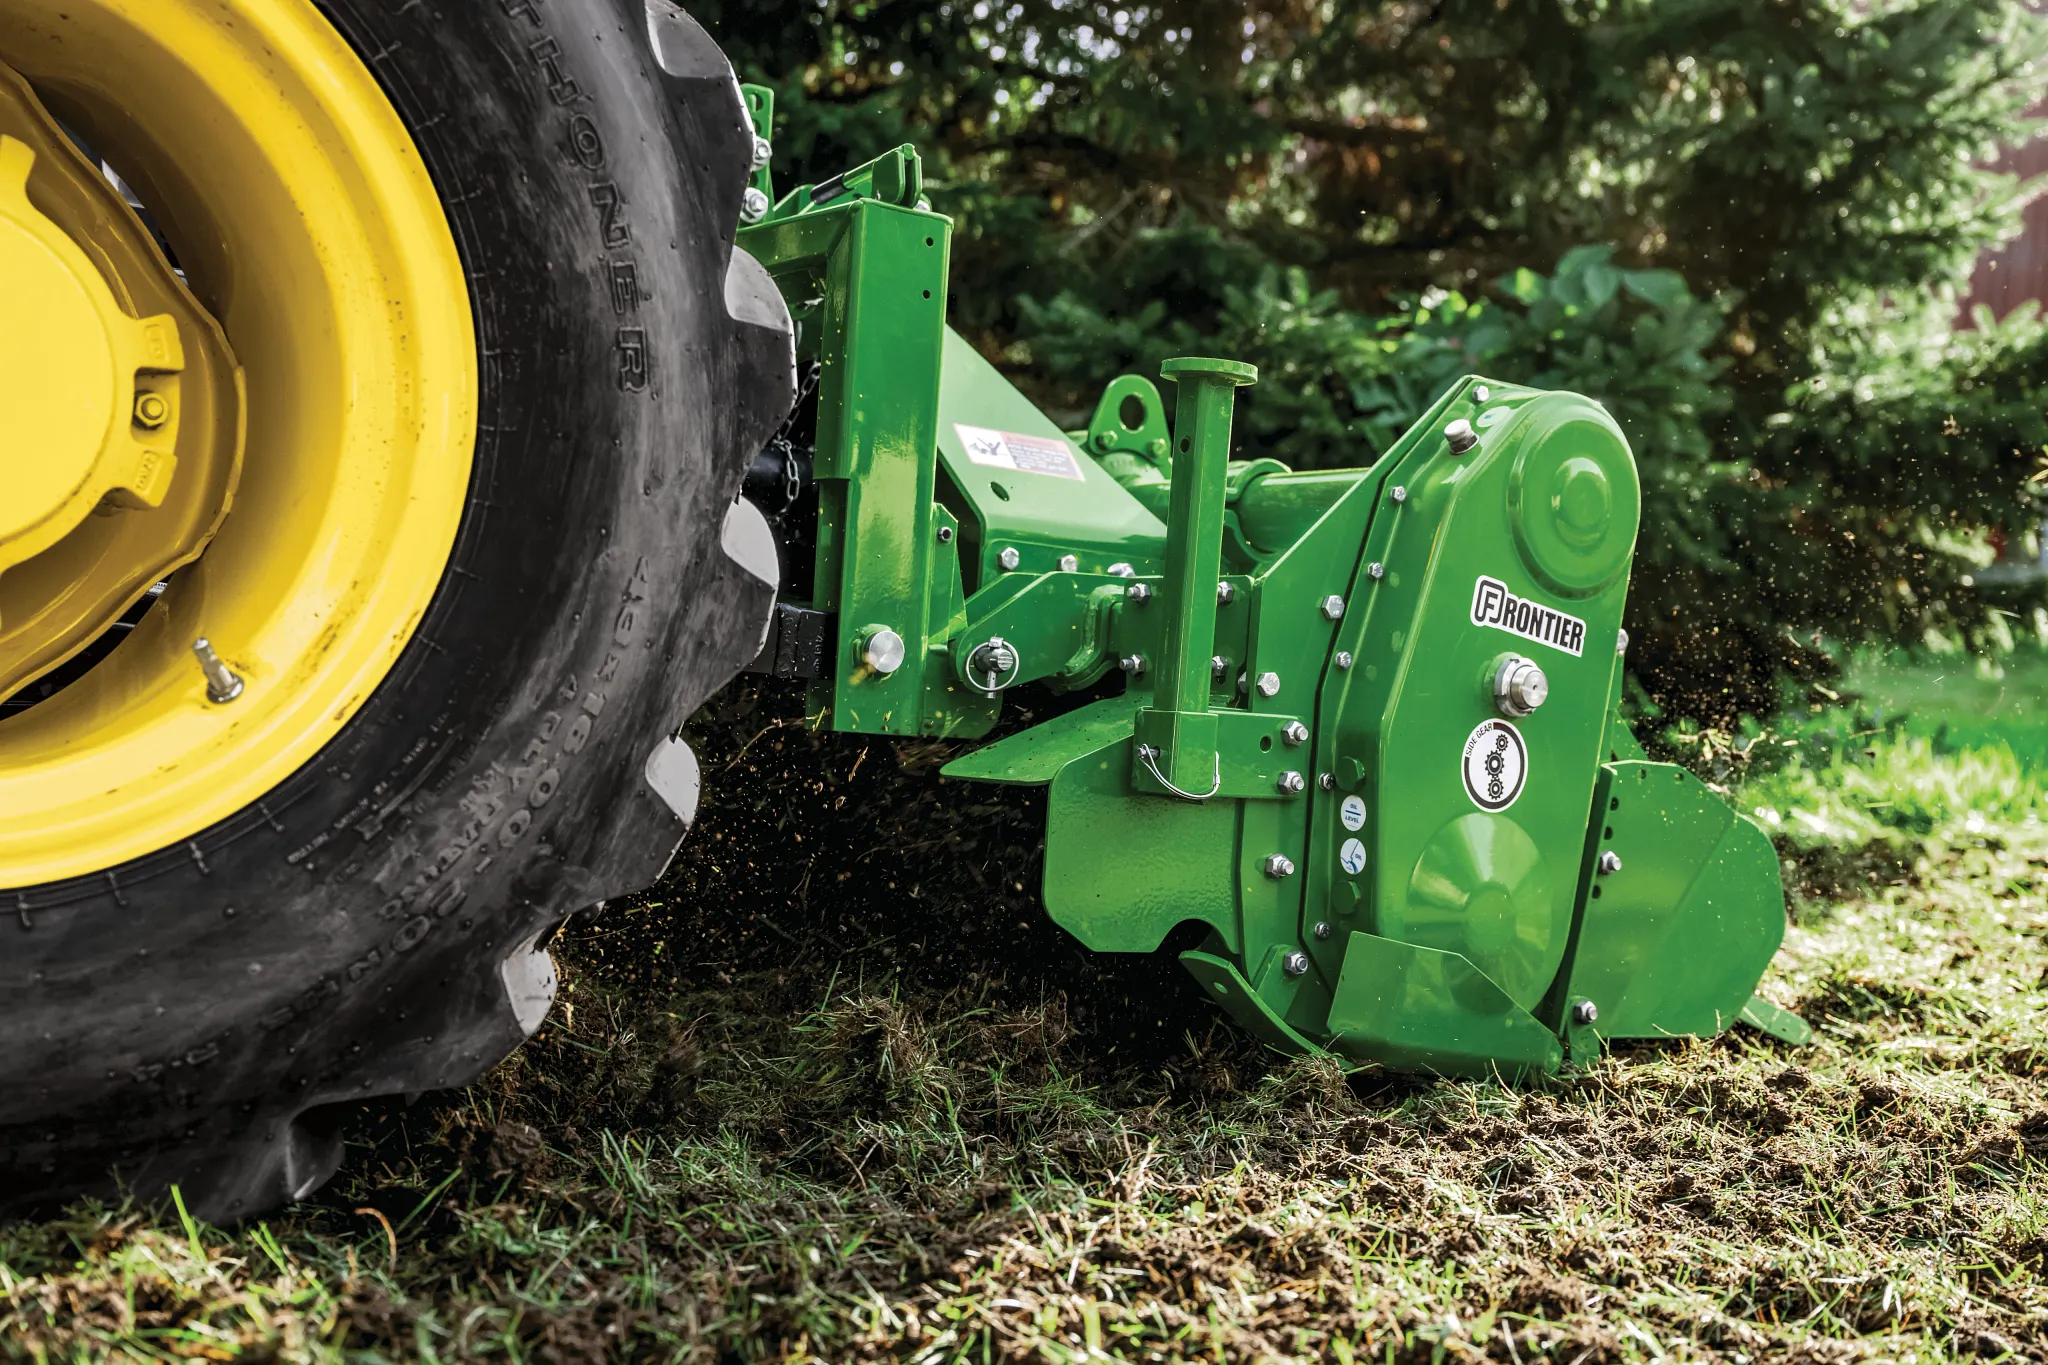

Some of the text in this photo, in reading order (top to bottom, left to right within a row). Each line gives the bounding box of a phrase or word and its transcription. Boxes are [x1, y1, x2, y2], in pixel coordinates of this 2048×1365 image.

[1475, 580, 1583, 652] FRONTIER
[1466, 722, 1493, 757] SIDE GEAR
[1345, 815, 1360, 823] LEVEL
